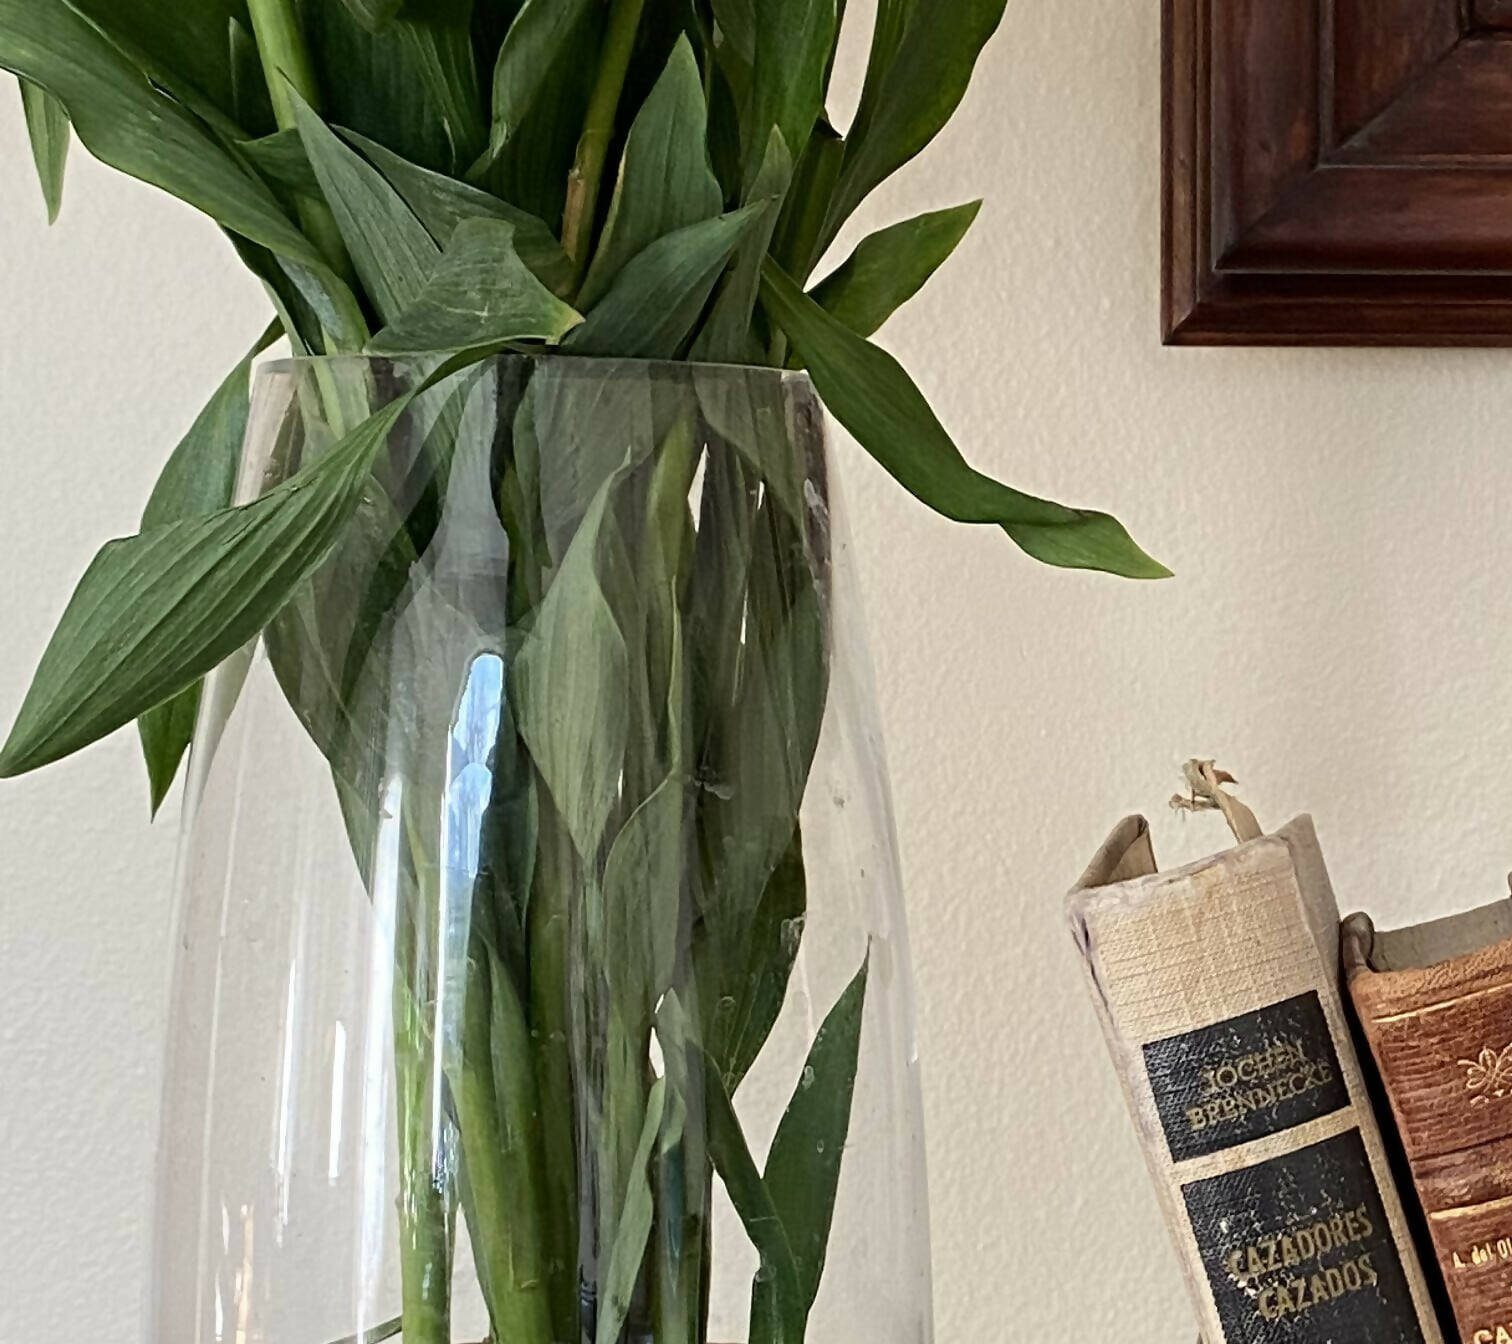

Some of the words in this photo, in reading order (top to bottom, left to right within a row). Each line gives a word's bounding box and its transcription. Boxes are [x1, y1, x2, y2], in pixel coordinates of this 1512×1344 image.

[1187, 1062, 1332, 1130] BRENNECKE
[1202, 1042, 1305, 1091] JOCHEN
[1226, 1206, 1374, 1277] CAZADORES
[1471, 1242, 1493, 1265] del
[1256, 1256, 1377, 1319] CAZADOS
